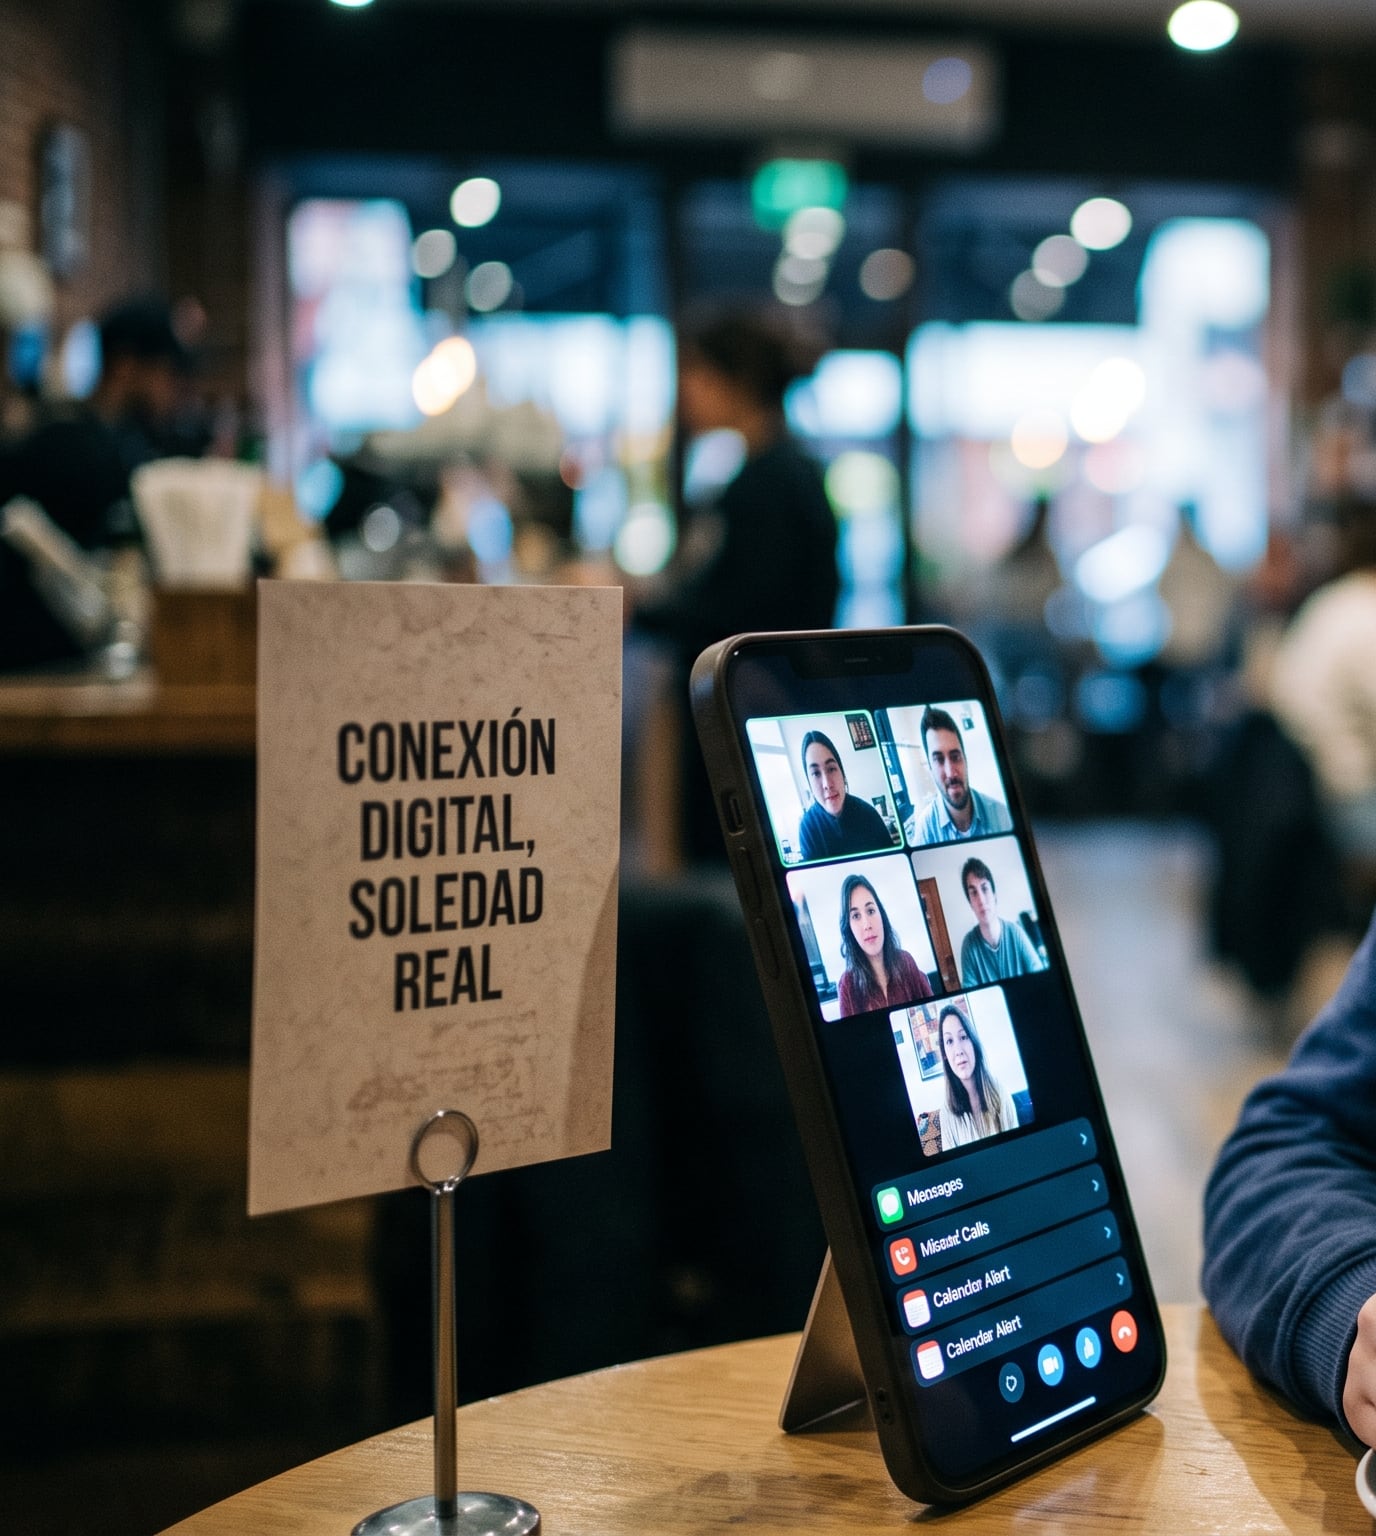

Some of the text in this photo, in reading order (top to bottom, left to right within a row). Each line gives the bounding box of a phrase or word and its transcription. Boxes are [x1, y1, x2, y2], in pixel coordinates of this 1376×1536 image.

[337, 707, 557, 785] CONEXIÓN
[360, 793, 536, 862] DIGITAL,
[348, 867, 544, 940] SOLEDAD
[393, 943, 503, 1013] REAL
[961, 1220, 990, 1242] Calls
